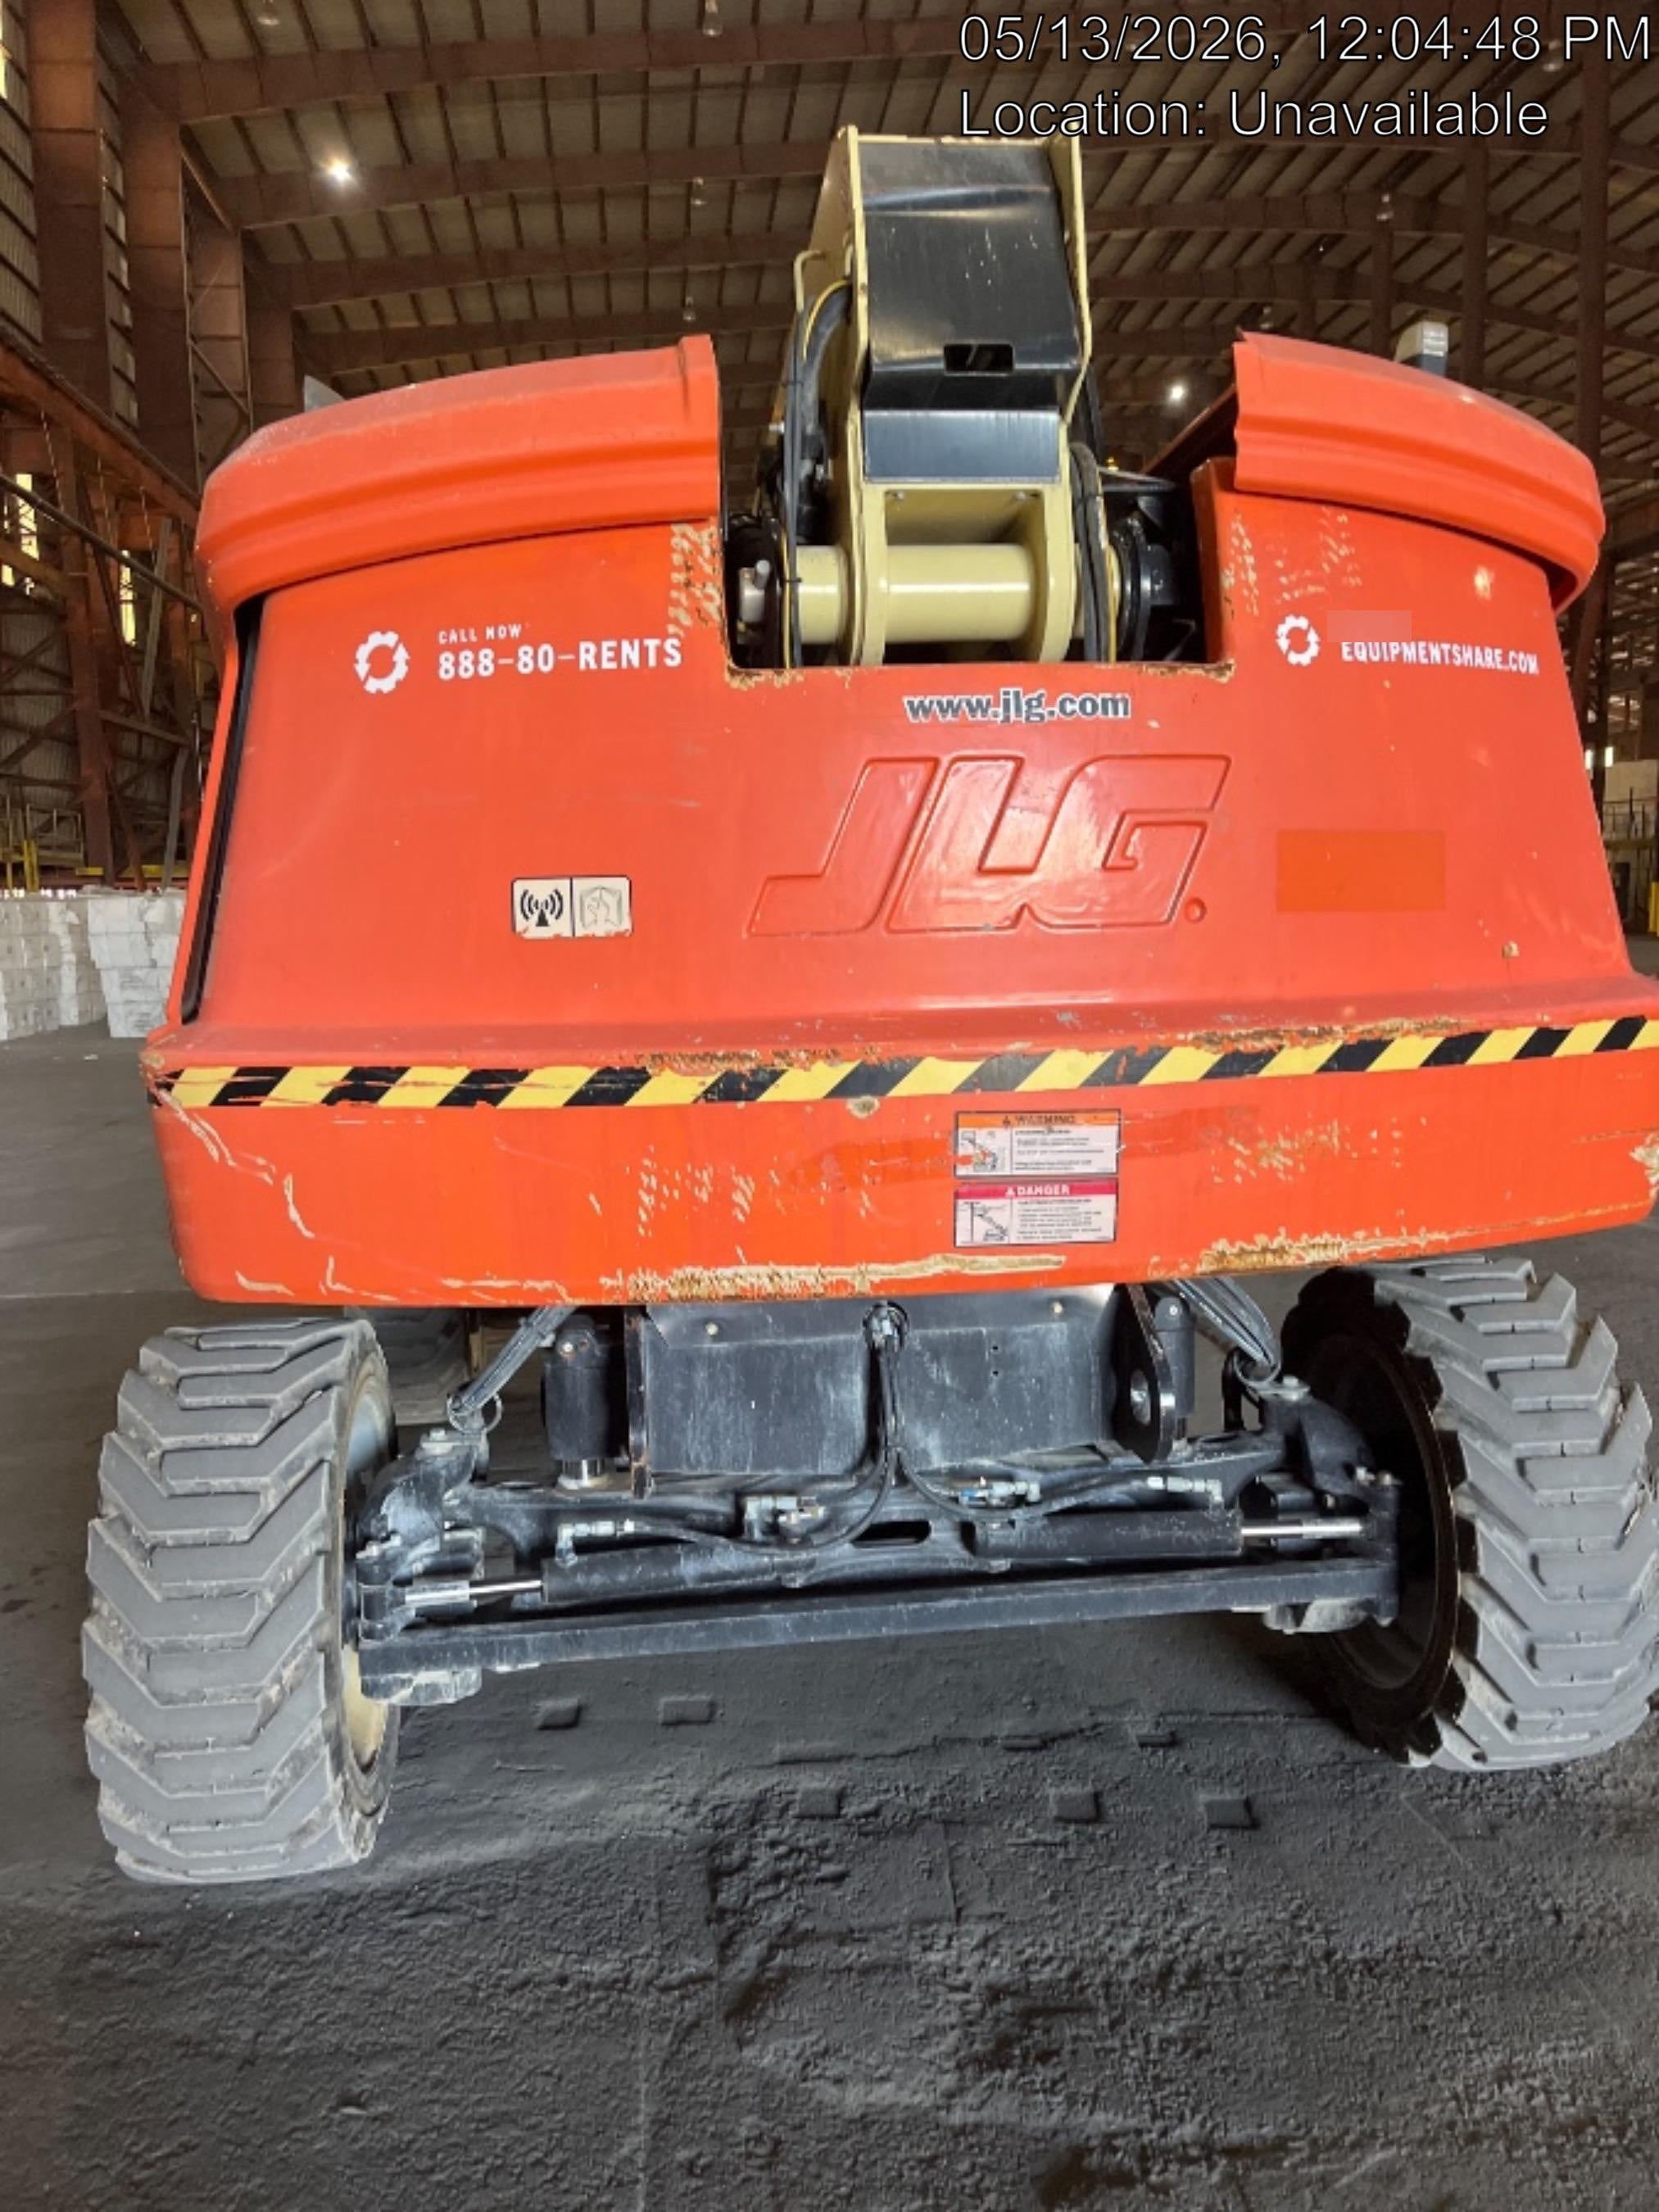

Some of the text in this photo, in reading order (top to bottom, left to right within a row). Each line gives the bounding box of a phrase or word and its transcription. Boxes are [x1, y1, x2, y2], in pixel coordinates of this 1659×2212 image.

[438, 623, 521, 644] CALL NOW
[438, 638, 682, 680] 888-80-RENTS
[1341, 641, 1539, 674] EQUIPMENTSHARE.COM
[905, 688, 1131, 724] www.jlg.com
[746, 754, 1231, 936] JLG
[1017, 1184, 1071, 1196] DANGER
